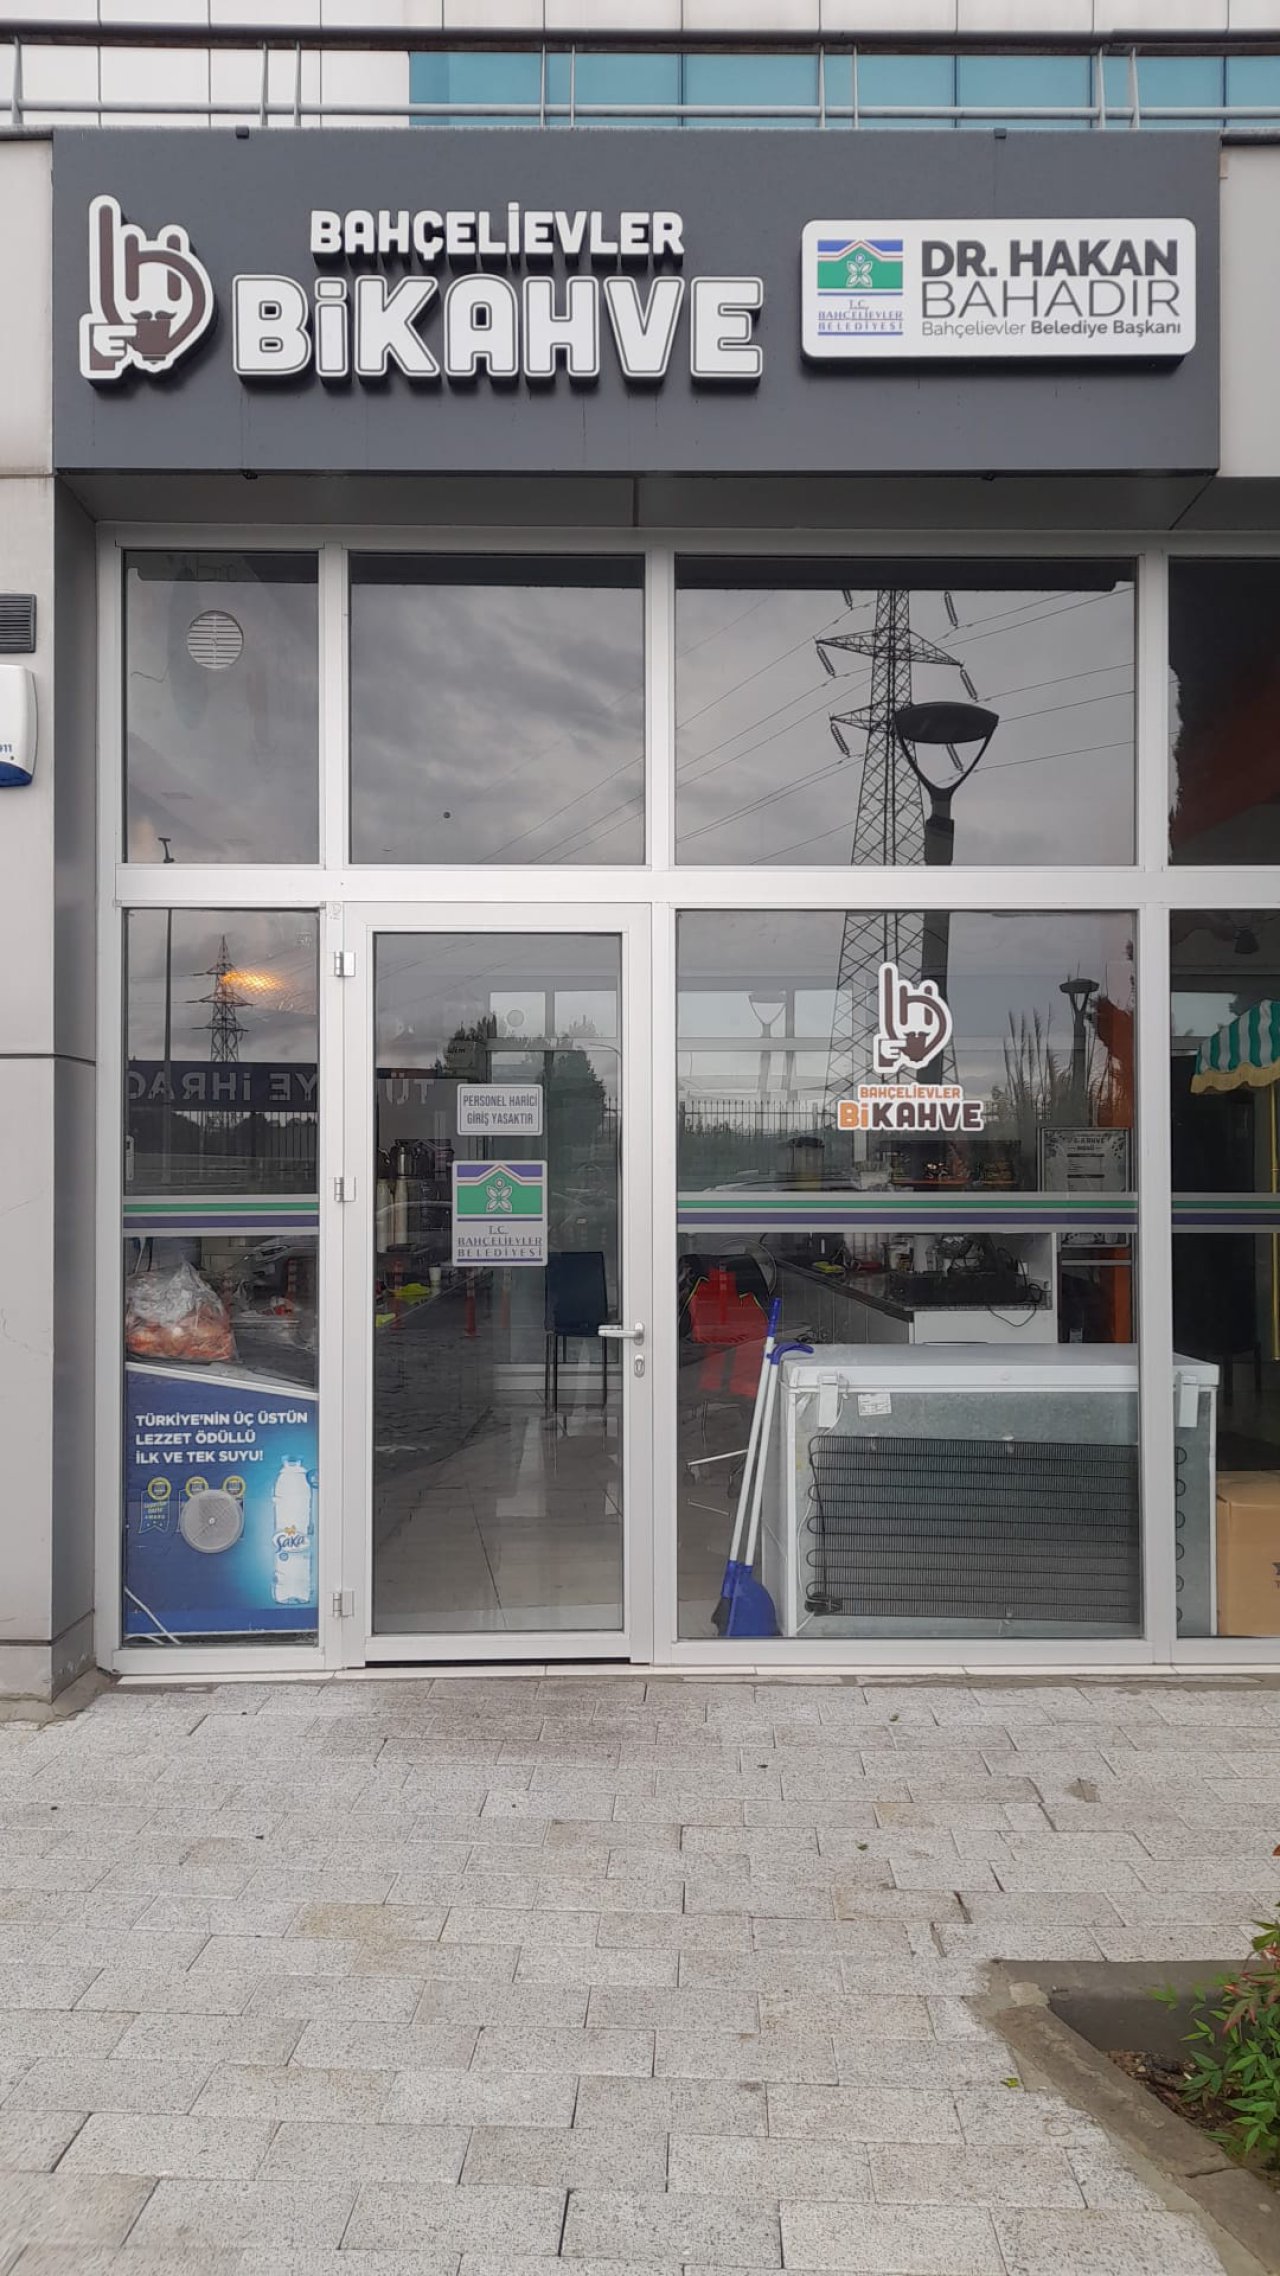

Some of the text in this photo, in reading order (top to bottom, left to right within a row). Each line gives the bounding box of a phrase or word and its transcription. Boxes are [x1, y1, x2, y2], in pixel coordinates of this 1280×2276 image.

[310, 202, 685, 260] BAHÇELİEVLER
[921, 239, 1178, 277] DR. HAKAN
[921, 280, 1180, 318] BAHADIR
[921, 321, 1181, 338] Bahçelievler Belediye Başkanı
[463, 1092, 537, 1107] PERSONEL HARİCİ
[859, 1085, 961, 1100] BAHÇELİEVLER
[467, 1109, 533, 1126] GİRİŞ YASAKTIR
[457, 1235, 542, 1247] BAHÇELİEVLER
[457, 1247, 542, 1257] BELEDİYESİ
[135, 1410, 308, 1427] TÜRKİYE'NİN ÜÇ ÜSTÜN
[135, 1430, 256, 1446] LEZZET ÖDÜLLÜ
[135, 1449, 264, 1464] İLK VE TEK SUYU!
